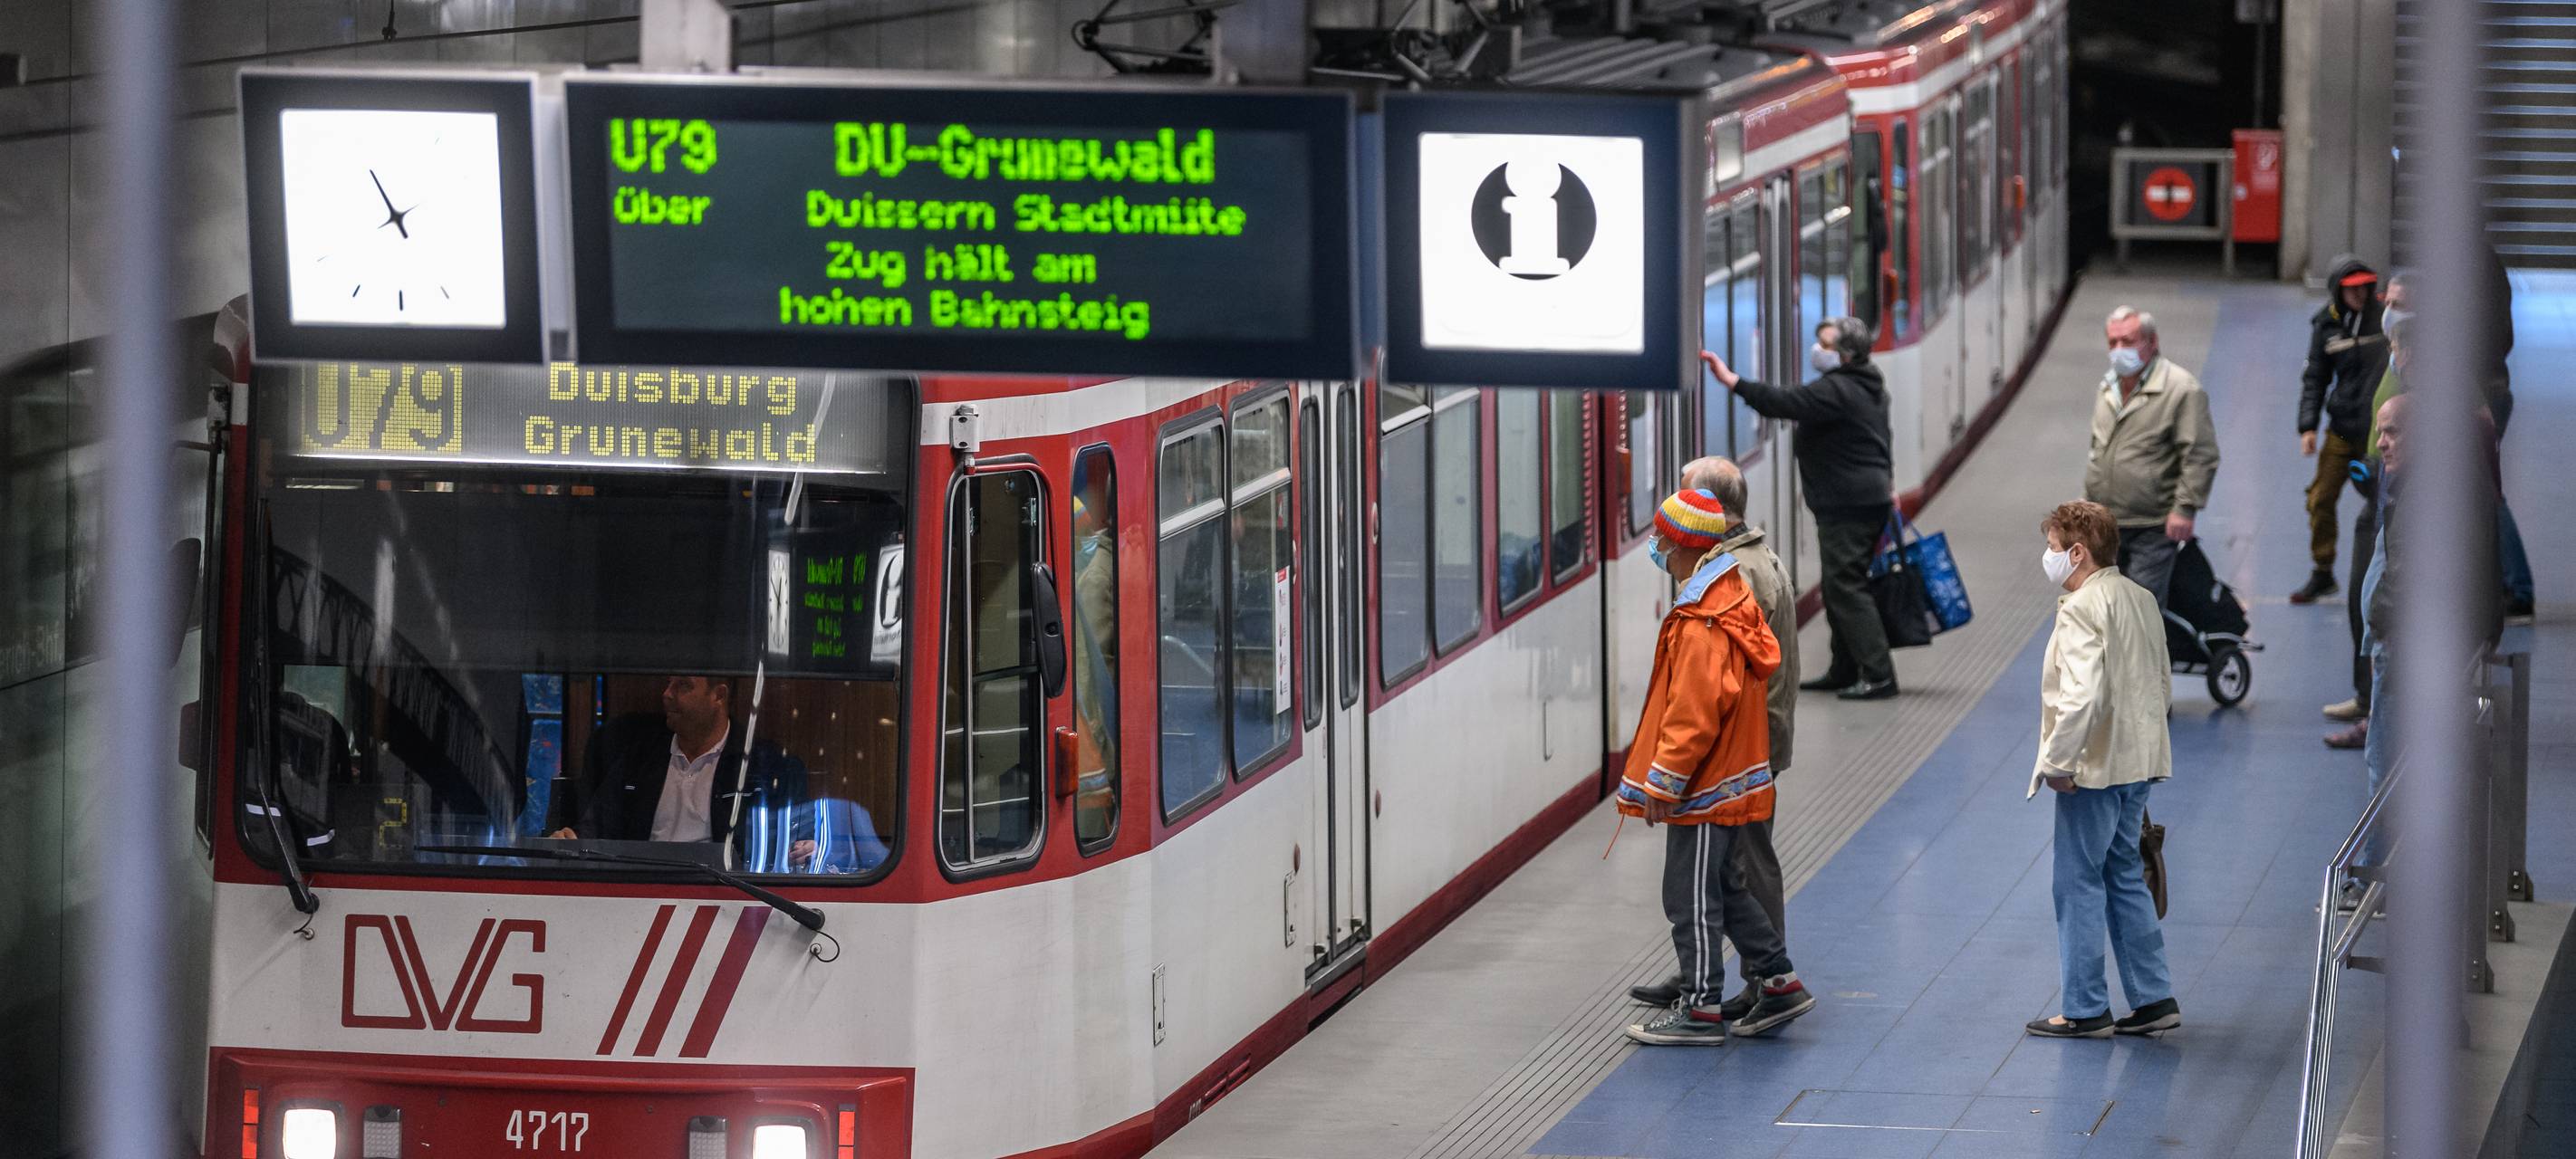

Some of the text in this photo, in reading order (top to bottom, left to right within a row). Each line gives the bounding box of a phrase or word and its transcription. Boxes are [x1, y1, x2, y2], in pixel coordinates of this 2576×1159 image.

[610, 118, 1216, 184] U79 DU-Grunewald
[613, 186, 712, 225] über
[806, 189, 995, 231] Duissern
[825, 241, 1097, 289] Zug hält am
[779, 286, 1150, 340] hohen Bahnsteig
[303, 362, 461, 453] U79
[550, 362, 797, 416] Duisburg
[525, 415, 815, 463] Grunewald
[341, 913, 546, 1034] DVG
[505, 1109, 590, 1152] 4717
